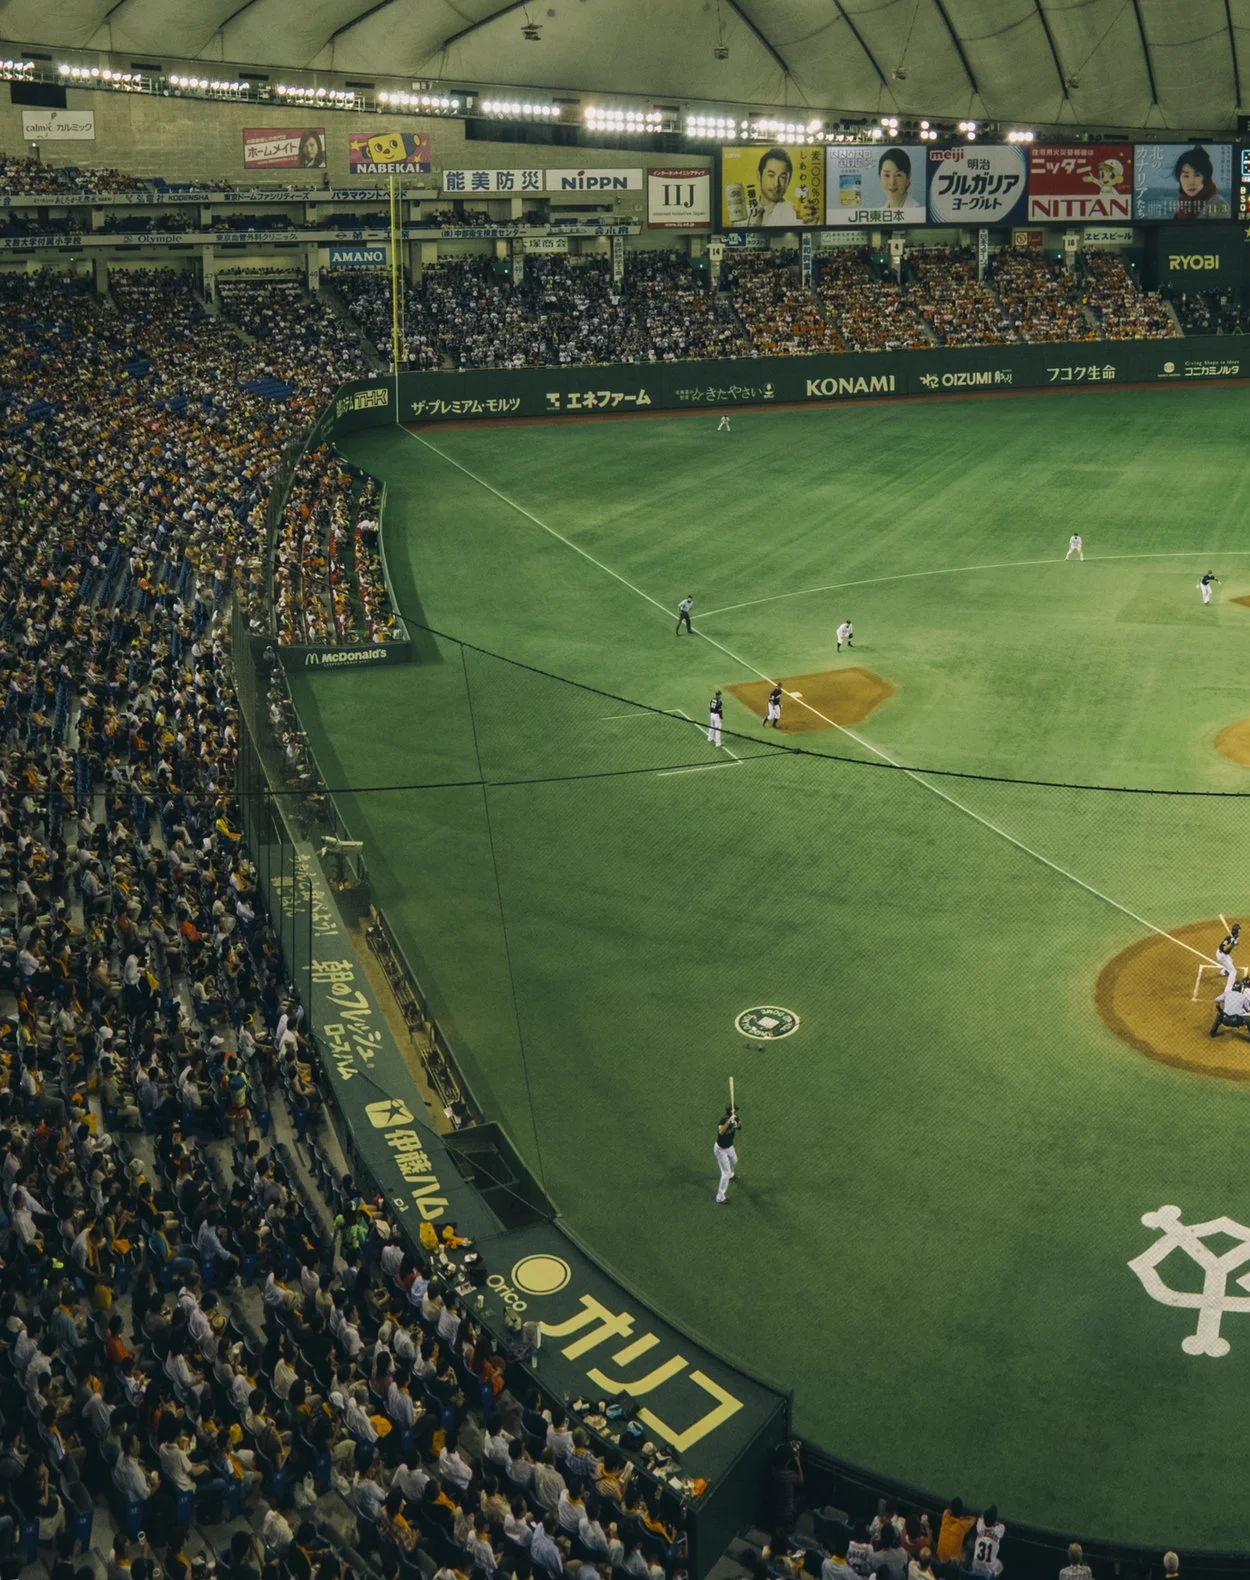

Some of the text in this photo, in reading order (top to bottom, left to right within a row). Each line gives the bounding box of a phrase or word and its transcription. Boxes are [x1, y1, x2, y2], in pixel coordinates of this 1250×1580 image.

[56, 123, 92, 132] カルミック
[247, 144, 297, 158] ホームメイト
[930, 147, 965, 162] meiji
[356, 163, 424, 174] NABEKAI.
[967, 159, 990, 170] 明治
[1030, 158, 1092, 175] ニッタン
[446, 171, 540, 191] 能美防災
[938, 171, 1020, 195] ブルガリア
[223, 192, 310, 201] 東京ドームファシリティーズ
[662, 183, 697, 209] IIJ
[952, 196, 1002, 211] ヨーグルト
[1032, 199, 1129, 217] NITTAN
[848, 210, 905, 223] JR東日本
[138, 235, 182, 244] Olympic
[521, 239, 566, 248] 塚商会
[332, 252, 383, 262] AMANO
[1168, 254, 1220, 270] RYOBI
[942, 371, 992, 387] OIZUMI
[1046, 364, 1116, 382] フコク生命
[1184, 365, 1239, 377] コニカミノルタ
[705, 384, 763, 402] きたやさい
[806, 375, 895, 396] KONAMI
[354, 389, 388, 409] THK
[566, 388, 652, 409] エネファーム
[321, 648, 388, 663] McDonald's
[384, 1129, 449, 1221] 伊藤ハム
[486, 1274, 528, 1312] Orico
[538, 1293, 745, 1454] オリコ
[976, 1541, 993, 1564] 31
